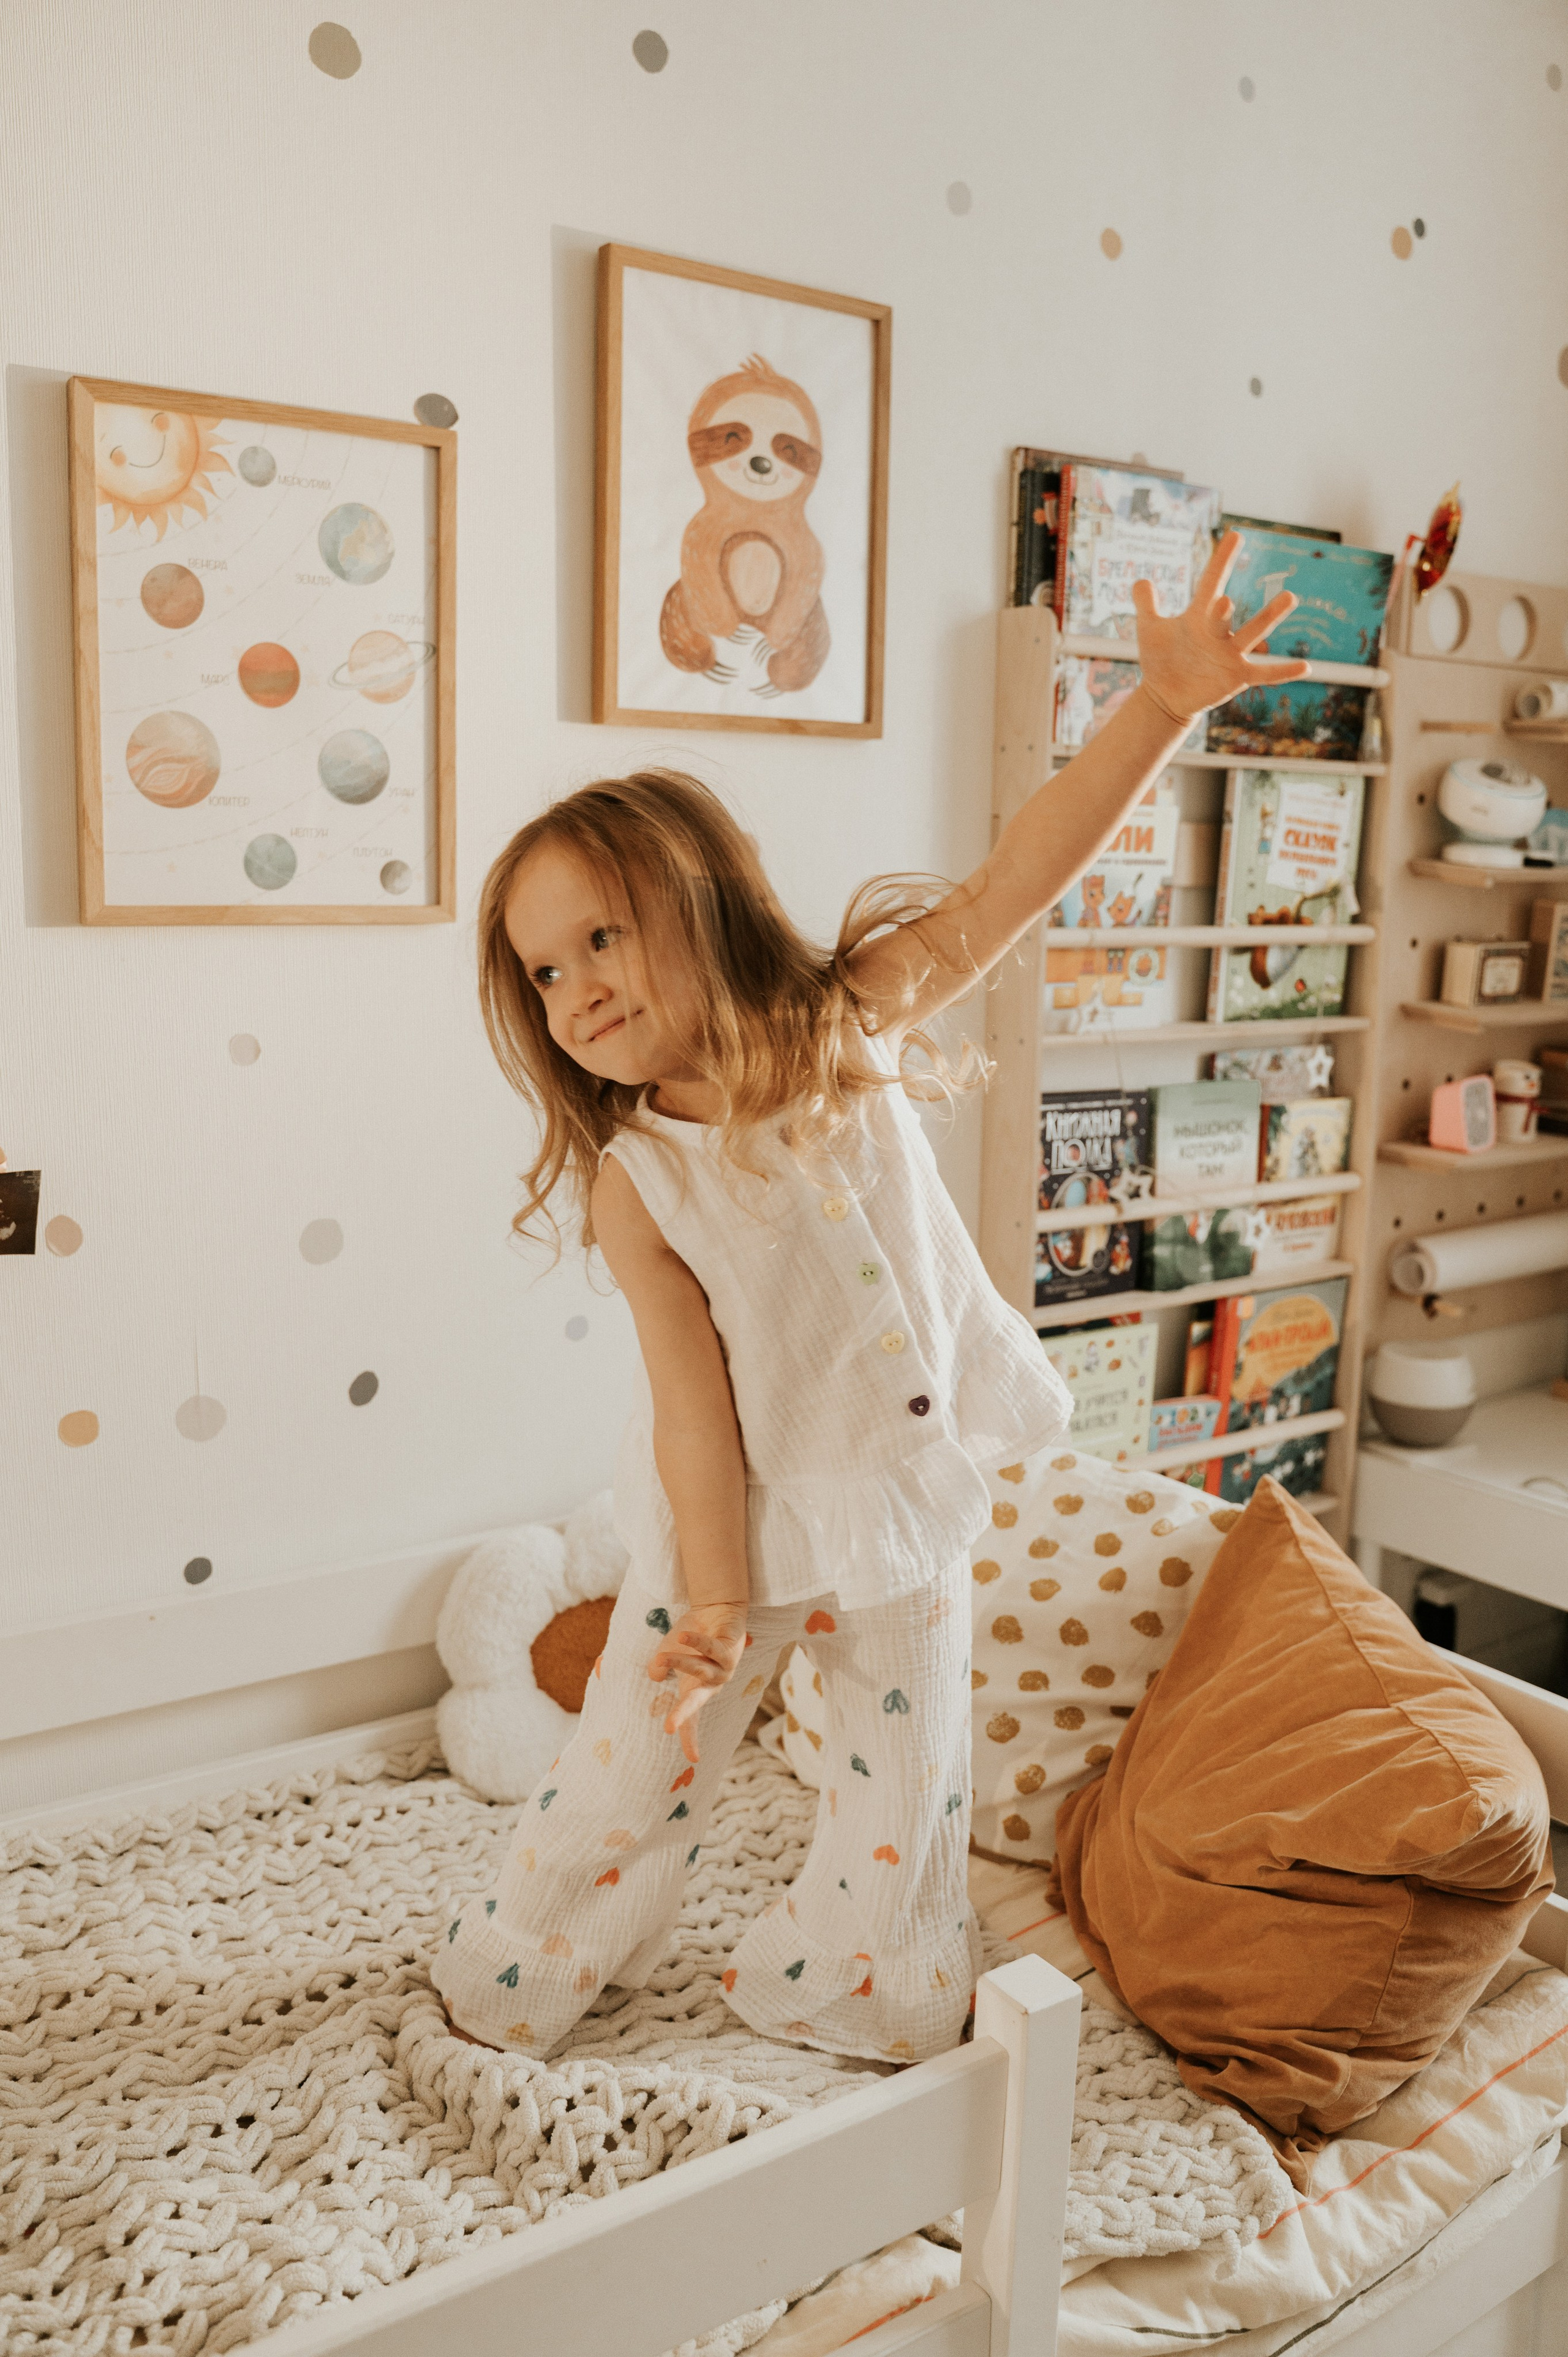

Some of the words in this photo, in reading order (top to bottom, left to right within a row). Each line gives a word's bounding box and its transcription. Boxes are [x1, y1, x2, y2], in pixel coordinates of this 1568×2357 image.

[187, 558, 228, 571] ВЕНЕРА
[201, 674, 230, 686] МАРС
[208, 796, 251, 807] ЮПИТЕР
[353, 847, 393, 858] ПЛУТОН
